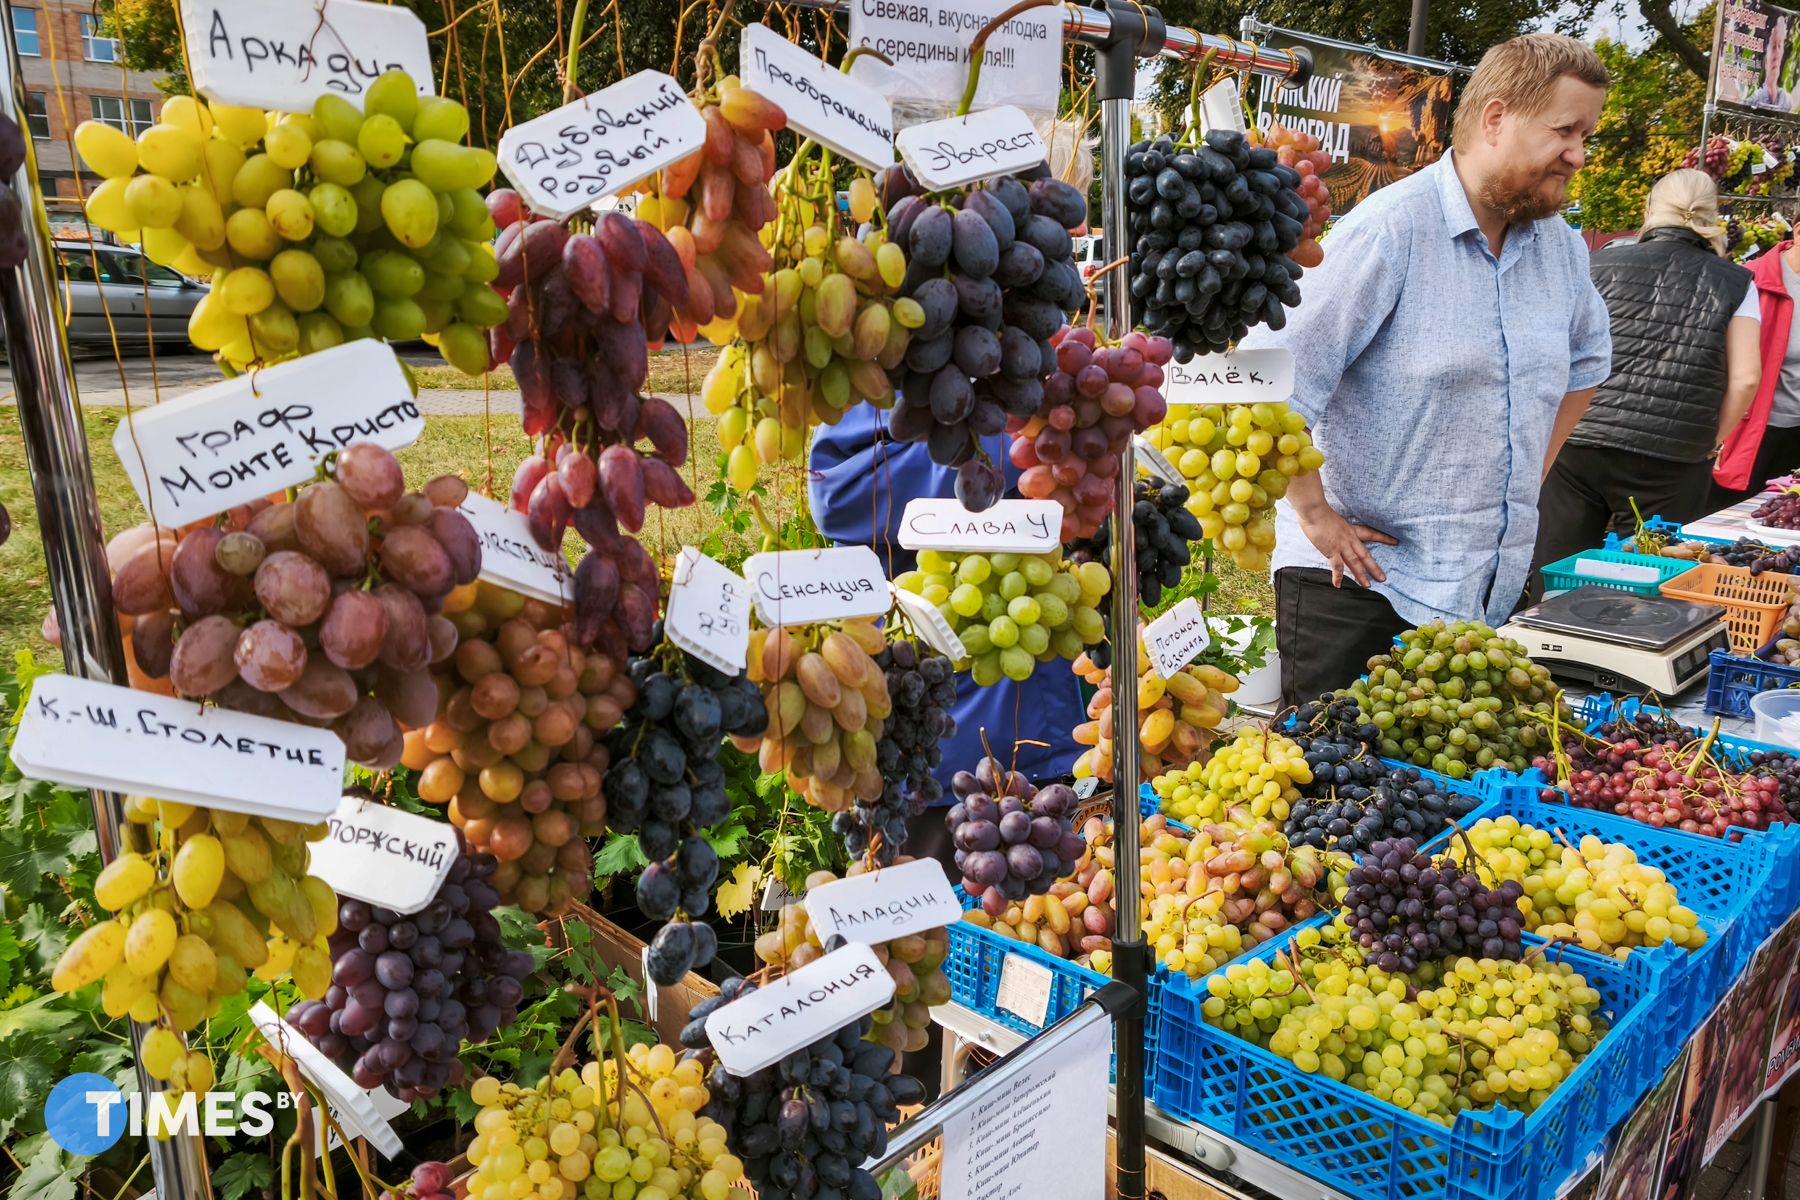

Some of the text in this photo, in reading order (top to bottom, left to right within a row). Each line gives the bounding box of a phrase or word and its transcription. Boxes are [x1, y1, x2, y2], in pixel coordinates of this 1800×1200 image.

[862, 0, 933, 27] Свежая,
[939, 9, 998, 33] вкусна
[876, 38, 959, 63] середины
[963, 46, 1015, 68] иля!!!
[515, 83, 686, 169] Дубовский
